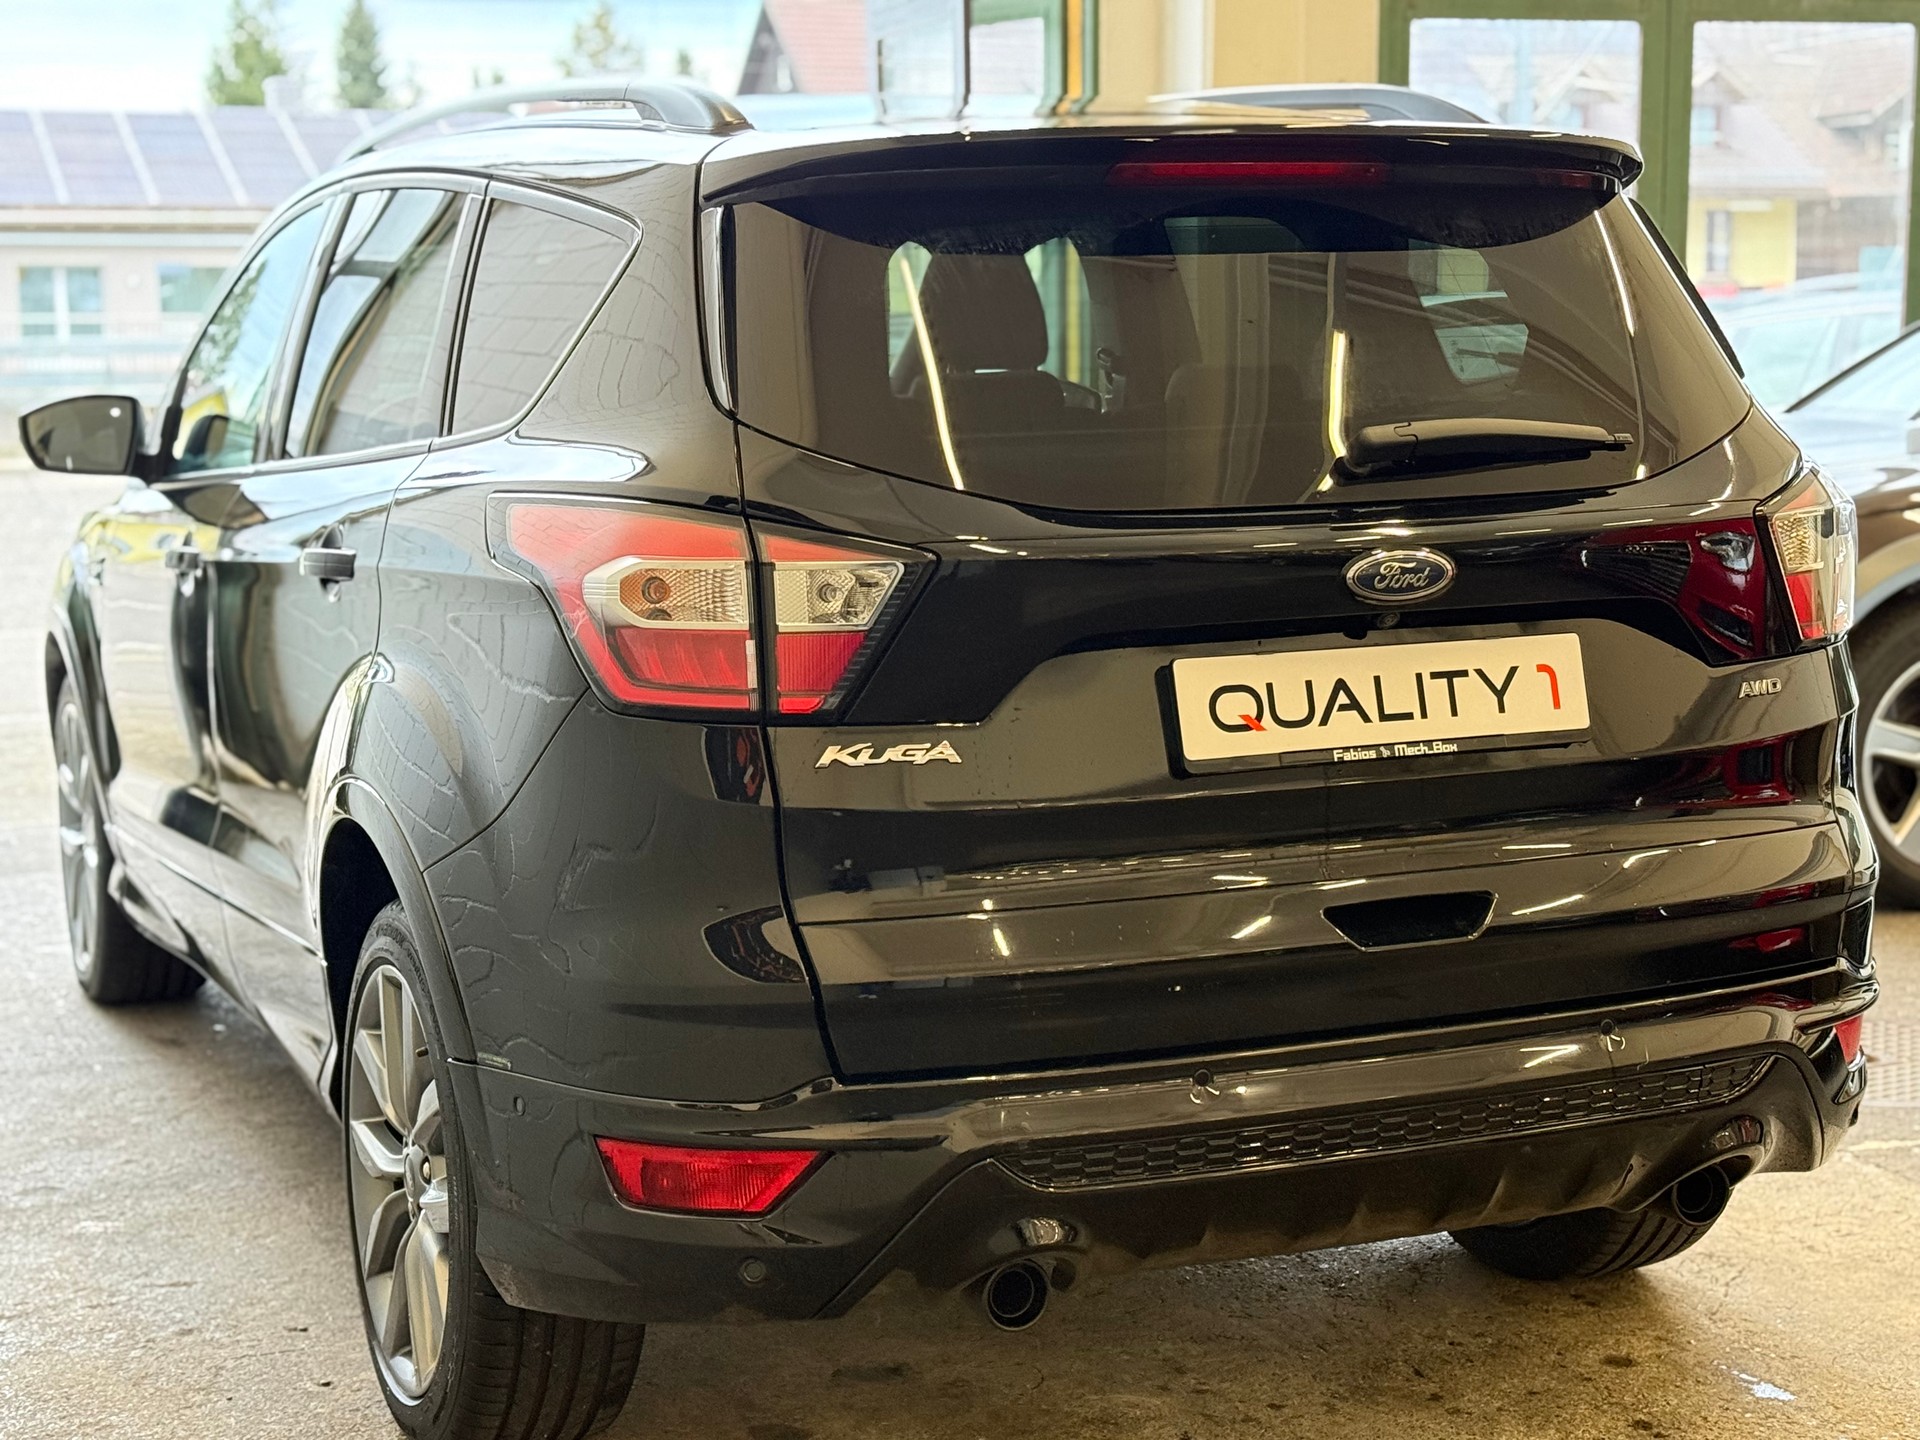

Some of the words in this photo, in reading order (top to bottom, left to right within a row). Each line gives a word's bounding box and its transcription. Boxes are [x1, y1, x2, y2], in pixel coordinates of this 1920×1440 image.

[1374, 561, 1430, 589] Ford
[1208, 665, 1520, 733] QUALITY
[1535, 663, 1561, 710] 1
[1738, 677, 1782, 699] AWD
[814, 740, 962, 769] KUGA
[1332, 748, 1377, 762] Fabios
